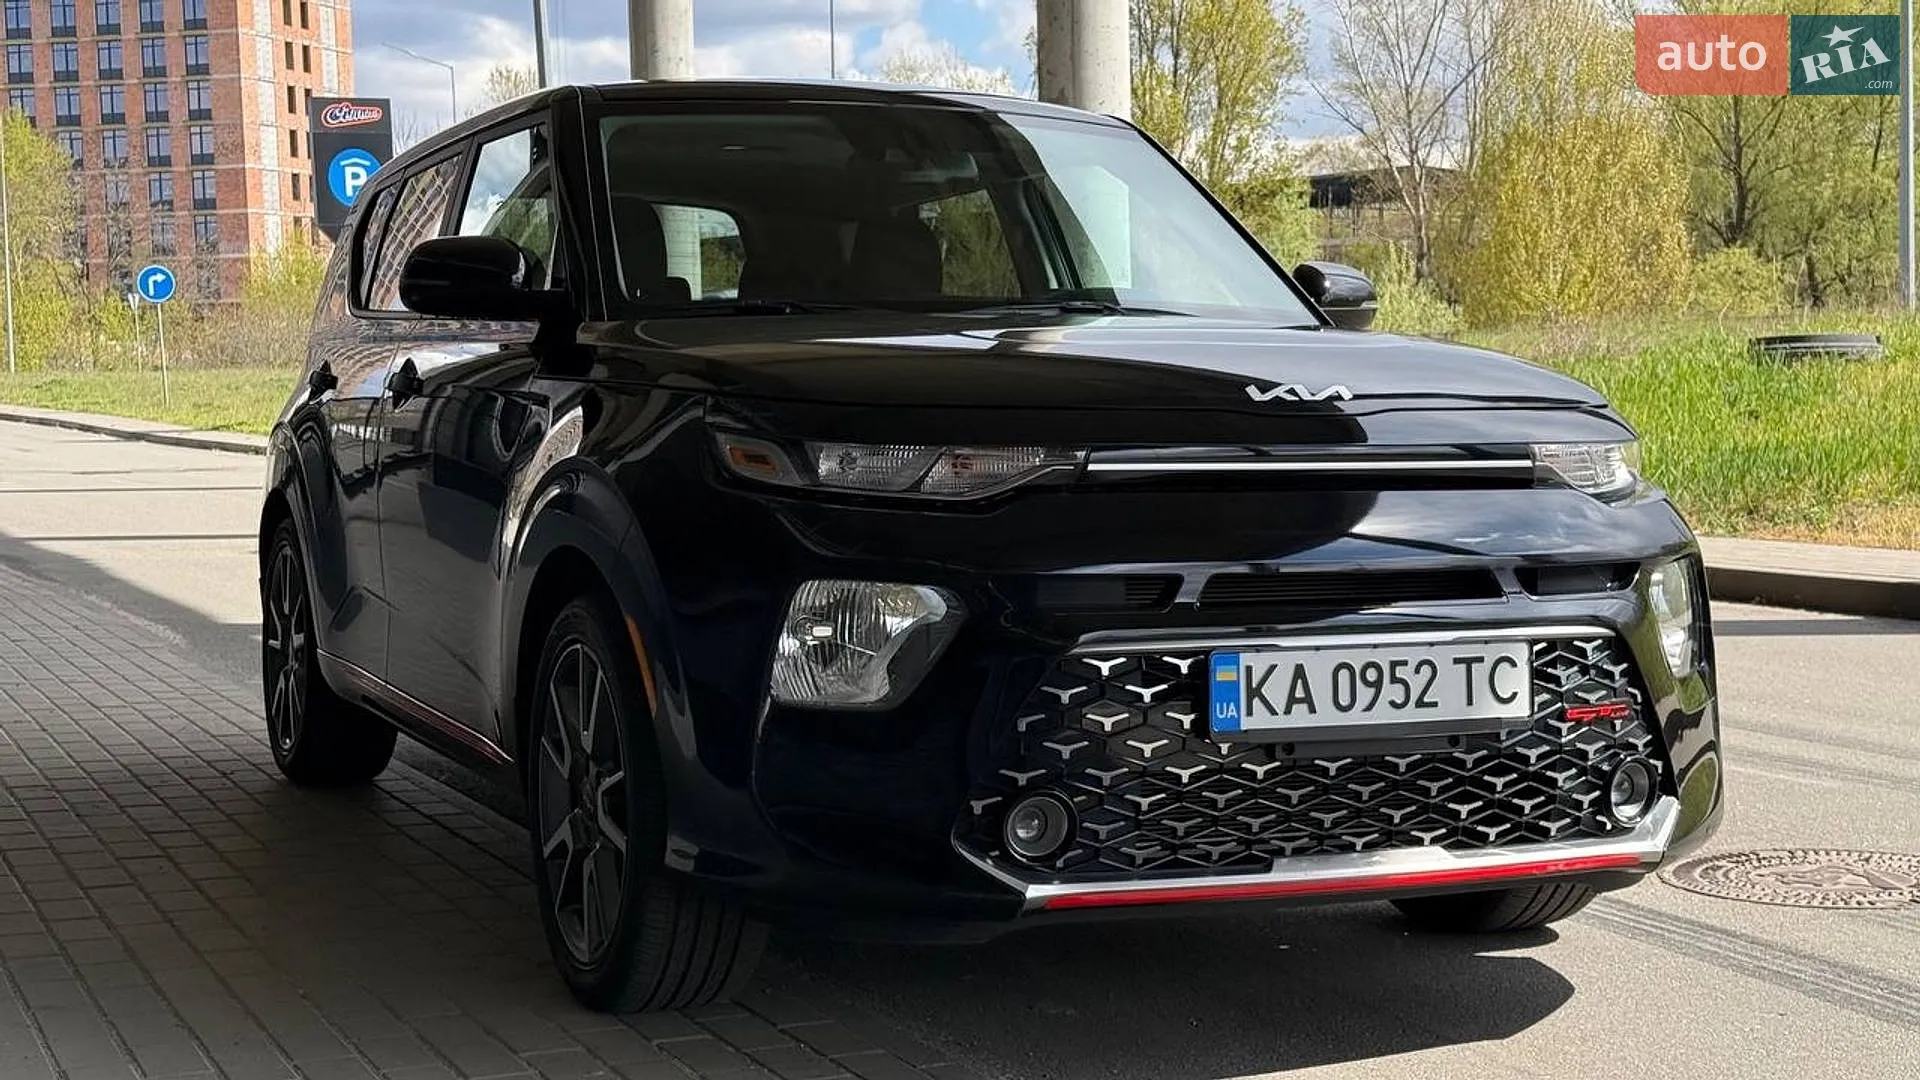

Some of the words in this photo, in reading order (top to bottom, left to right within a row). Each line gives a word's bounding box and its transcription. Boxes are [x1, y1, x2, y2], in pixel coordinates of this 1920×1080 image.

[345, 166, 368, 197] P
[1245, 663, 1317, 717] KA
[1331, 659, 1439, 712] 0952
[1452, 655, 1519, 705] TC
[1216, 702, 1239, 719] UA
